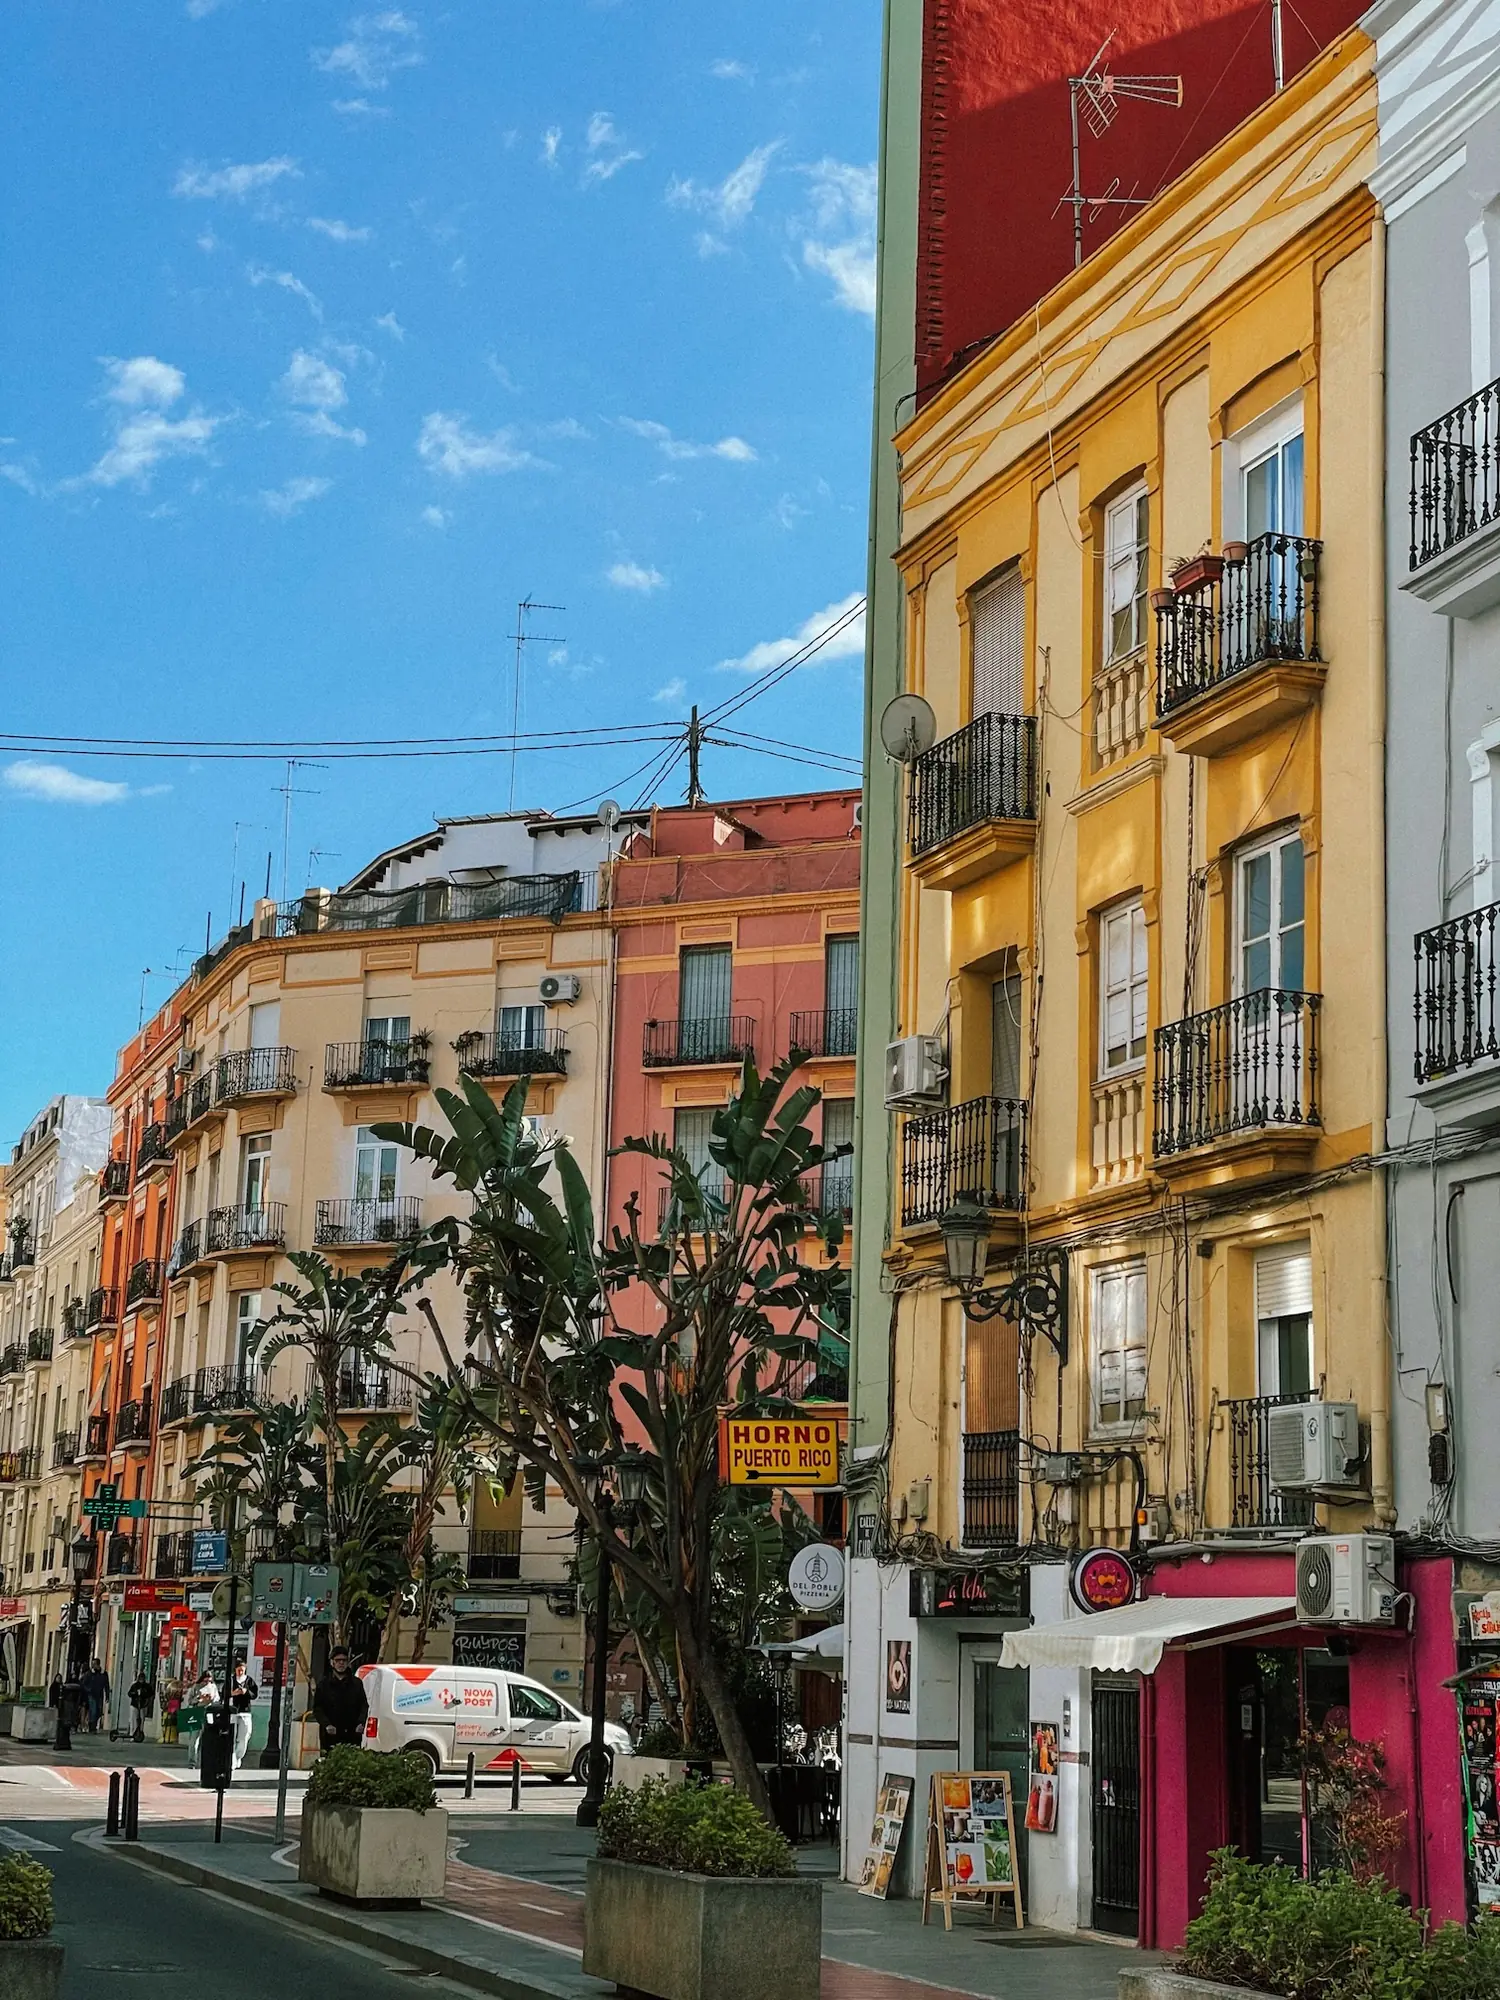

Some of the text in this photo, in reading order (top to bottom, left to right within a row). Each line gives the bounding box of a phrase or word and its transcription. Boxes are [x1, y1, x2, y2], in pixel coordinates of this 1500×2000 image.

[733, 1425, 830, 1444] HORNO
[734, 1449, 831, 1467] PUERTO RICO
[792, 1582, 838, 1592] DEL POBLE
[463, 1688, 494, 1698] NOVA
[464, 1698, 493, 1707] POST
